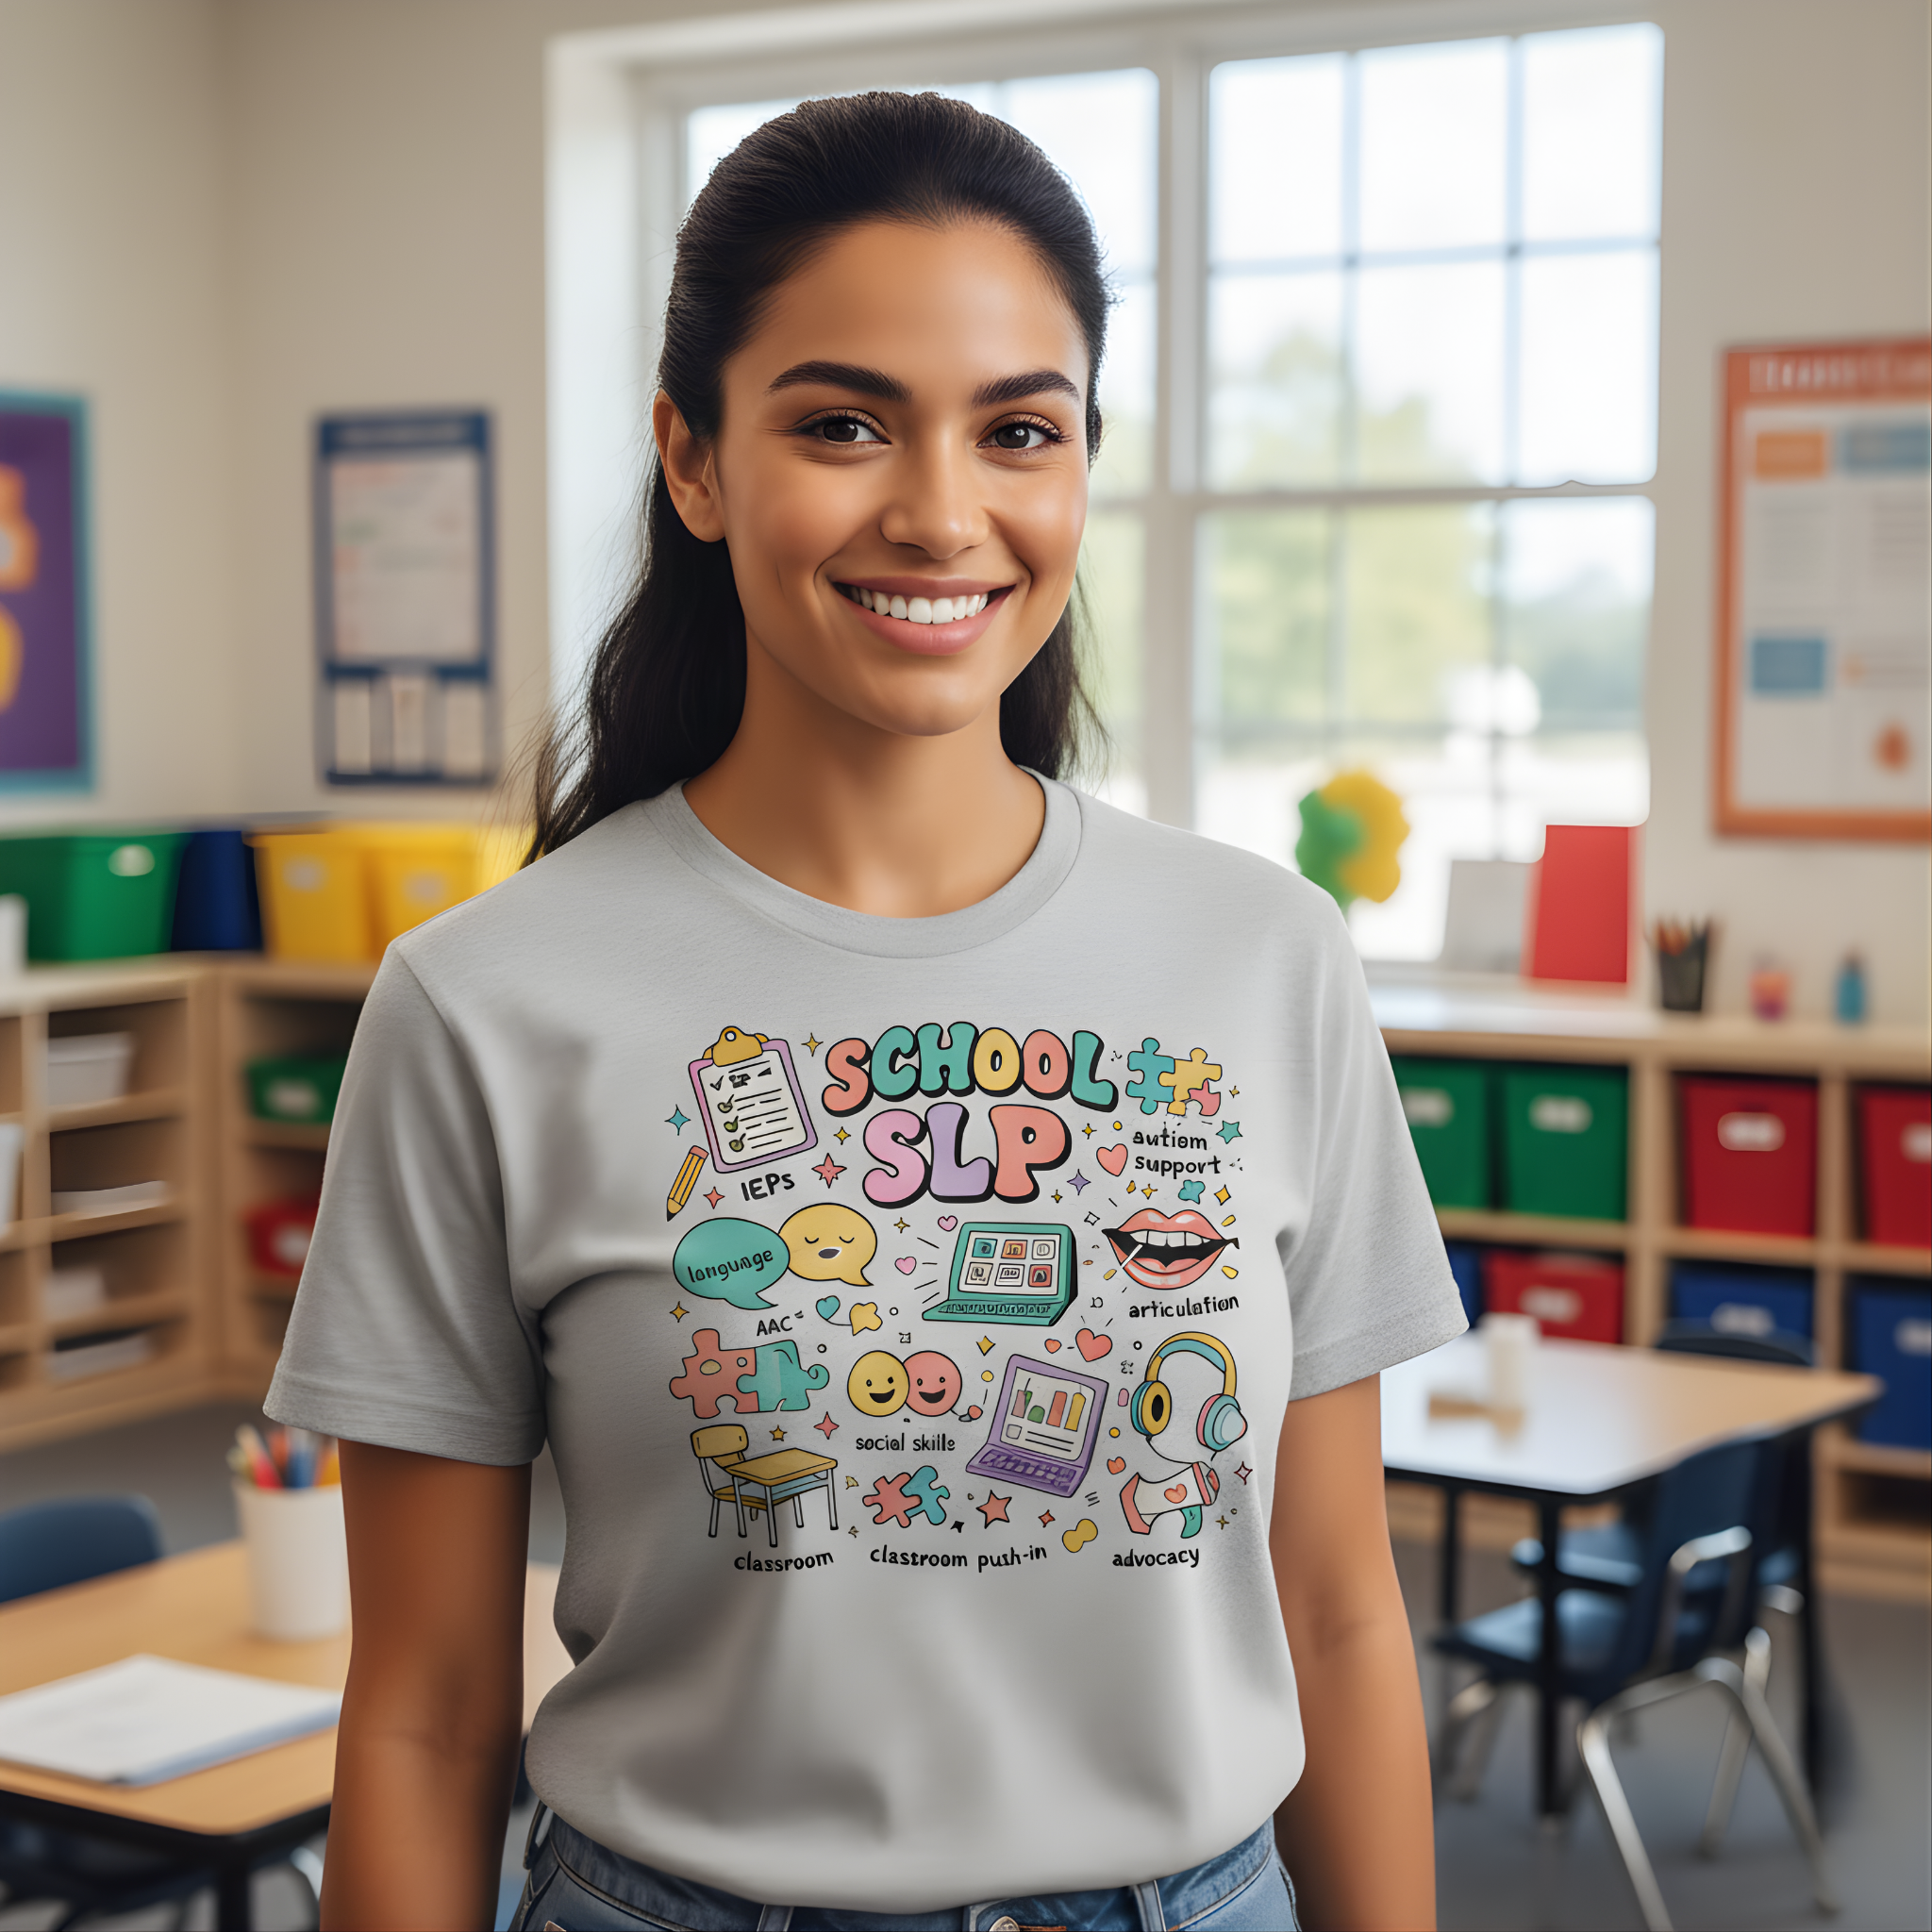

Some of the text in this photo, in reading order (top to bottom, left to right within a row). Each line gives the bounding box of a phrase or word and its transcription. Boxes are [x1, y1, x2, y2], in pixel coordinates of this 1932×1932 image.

[822, 1022, 1119, 1116] SCHOOL
[862, 1103, 1072, 1208] SLP
[1135, 1156, 1222, 1179] support
[741, 1173, 795, 1202] IEPs
[756, 1316, 793, 1337] AAC
[856, 1432, 905, 1451] social
[734, 1551, 834, 1572] classroom
[977, 1544, 1047, 1574] push-in
[1112, 1548, 1200, 1569] advocacy
